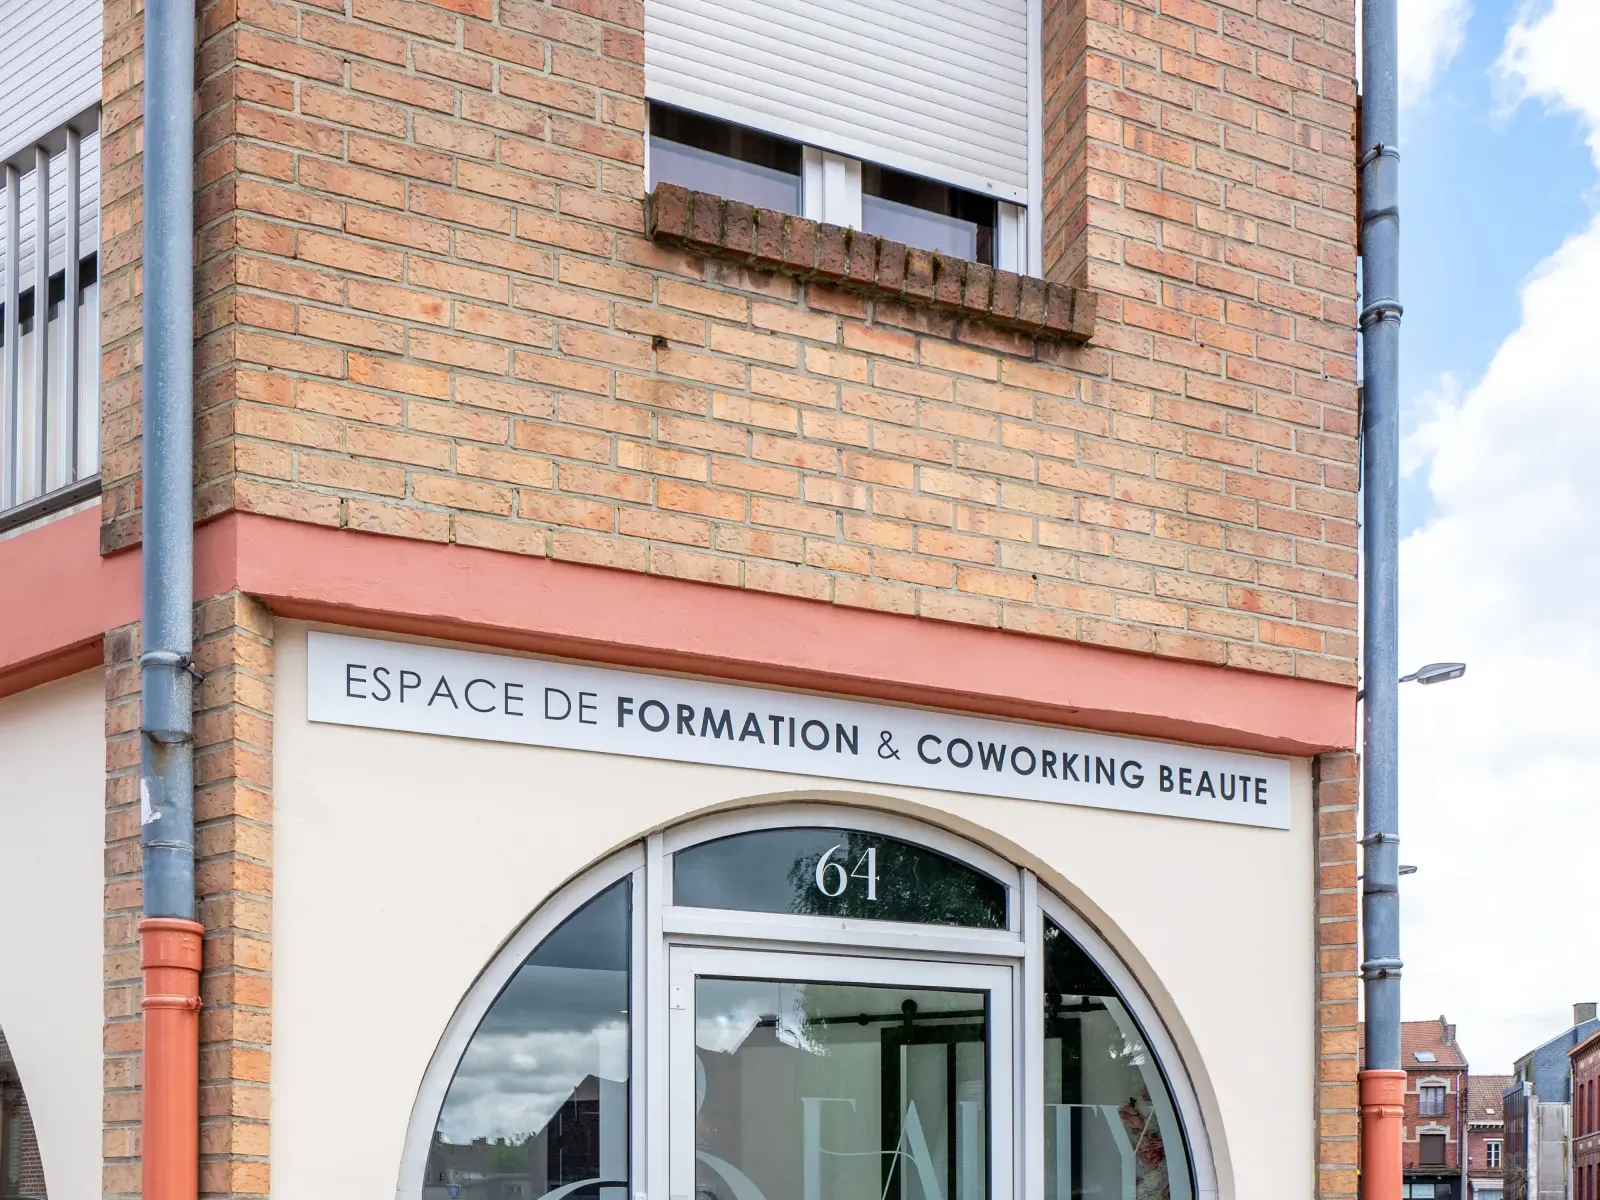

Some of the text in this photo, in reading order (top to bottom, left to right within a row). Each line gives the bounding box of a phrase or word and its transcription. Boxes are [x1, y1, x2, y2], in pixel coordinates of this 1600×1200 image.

[347, 664, 1266, 804] ESPACE DE FORMATION & COWORKING BEAUTE
[816, 845, 879, 900] 64
